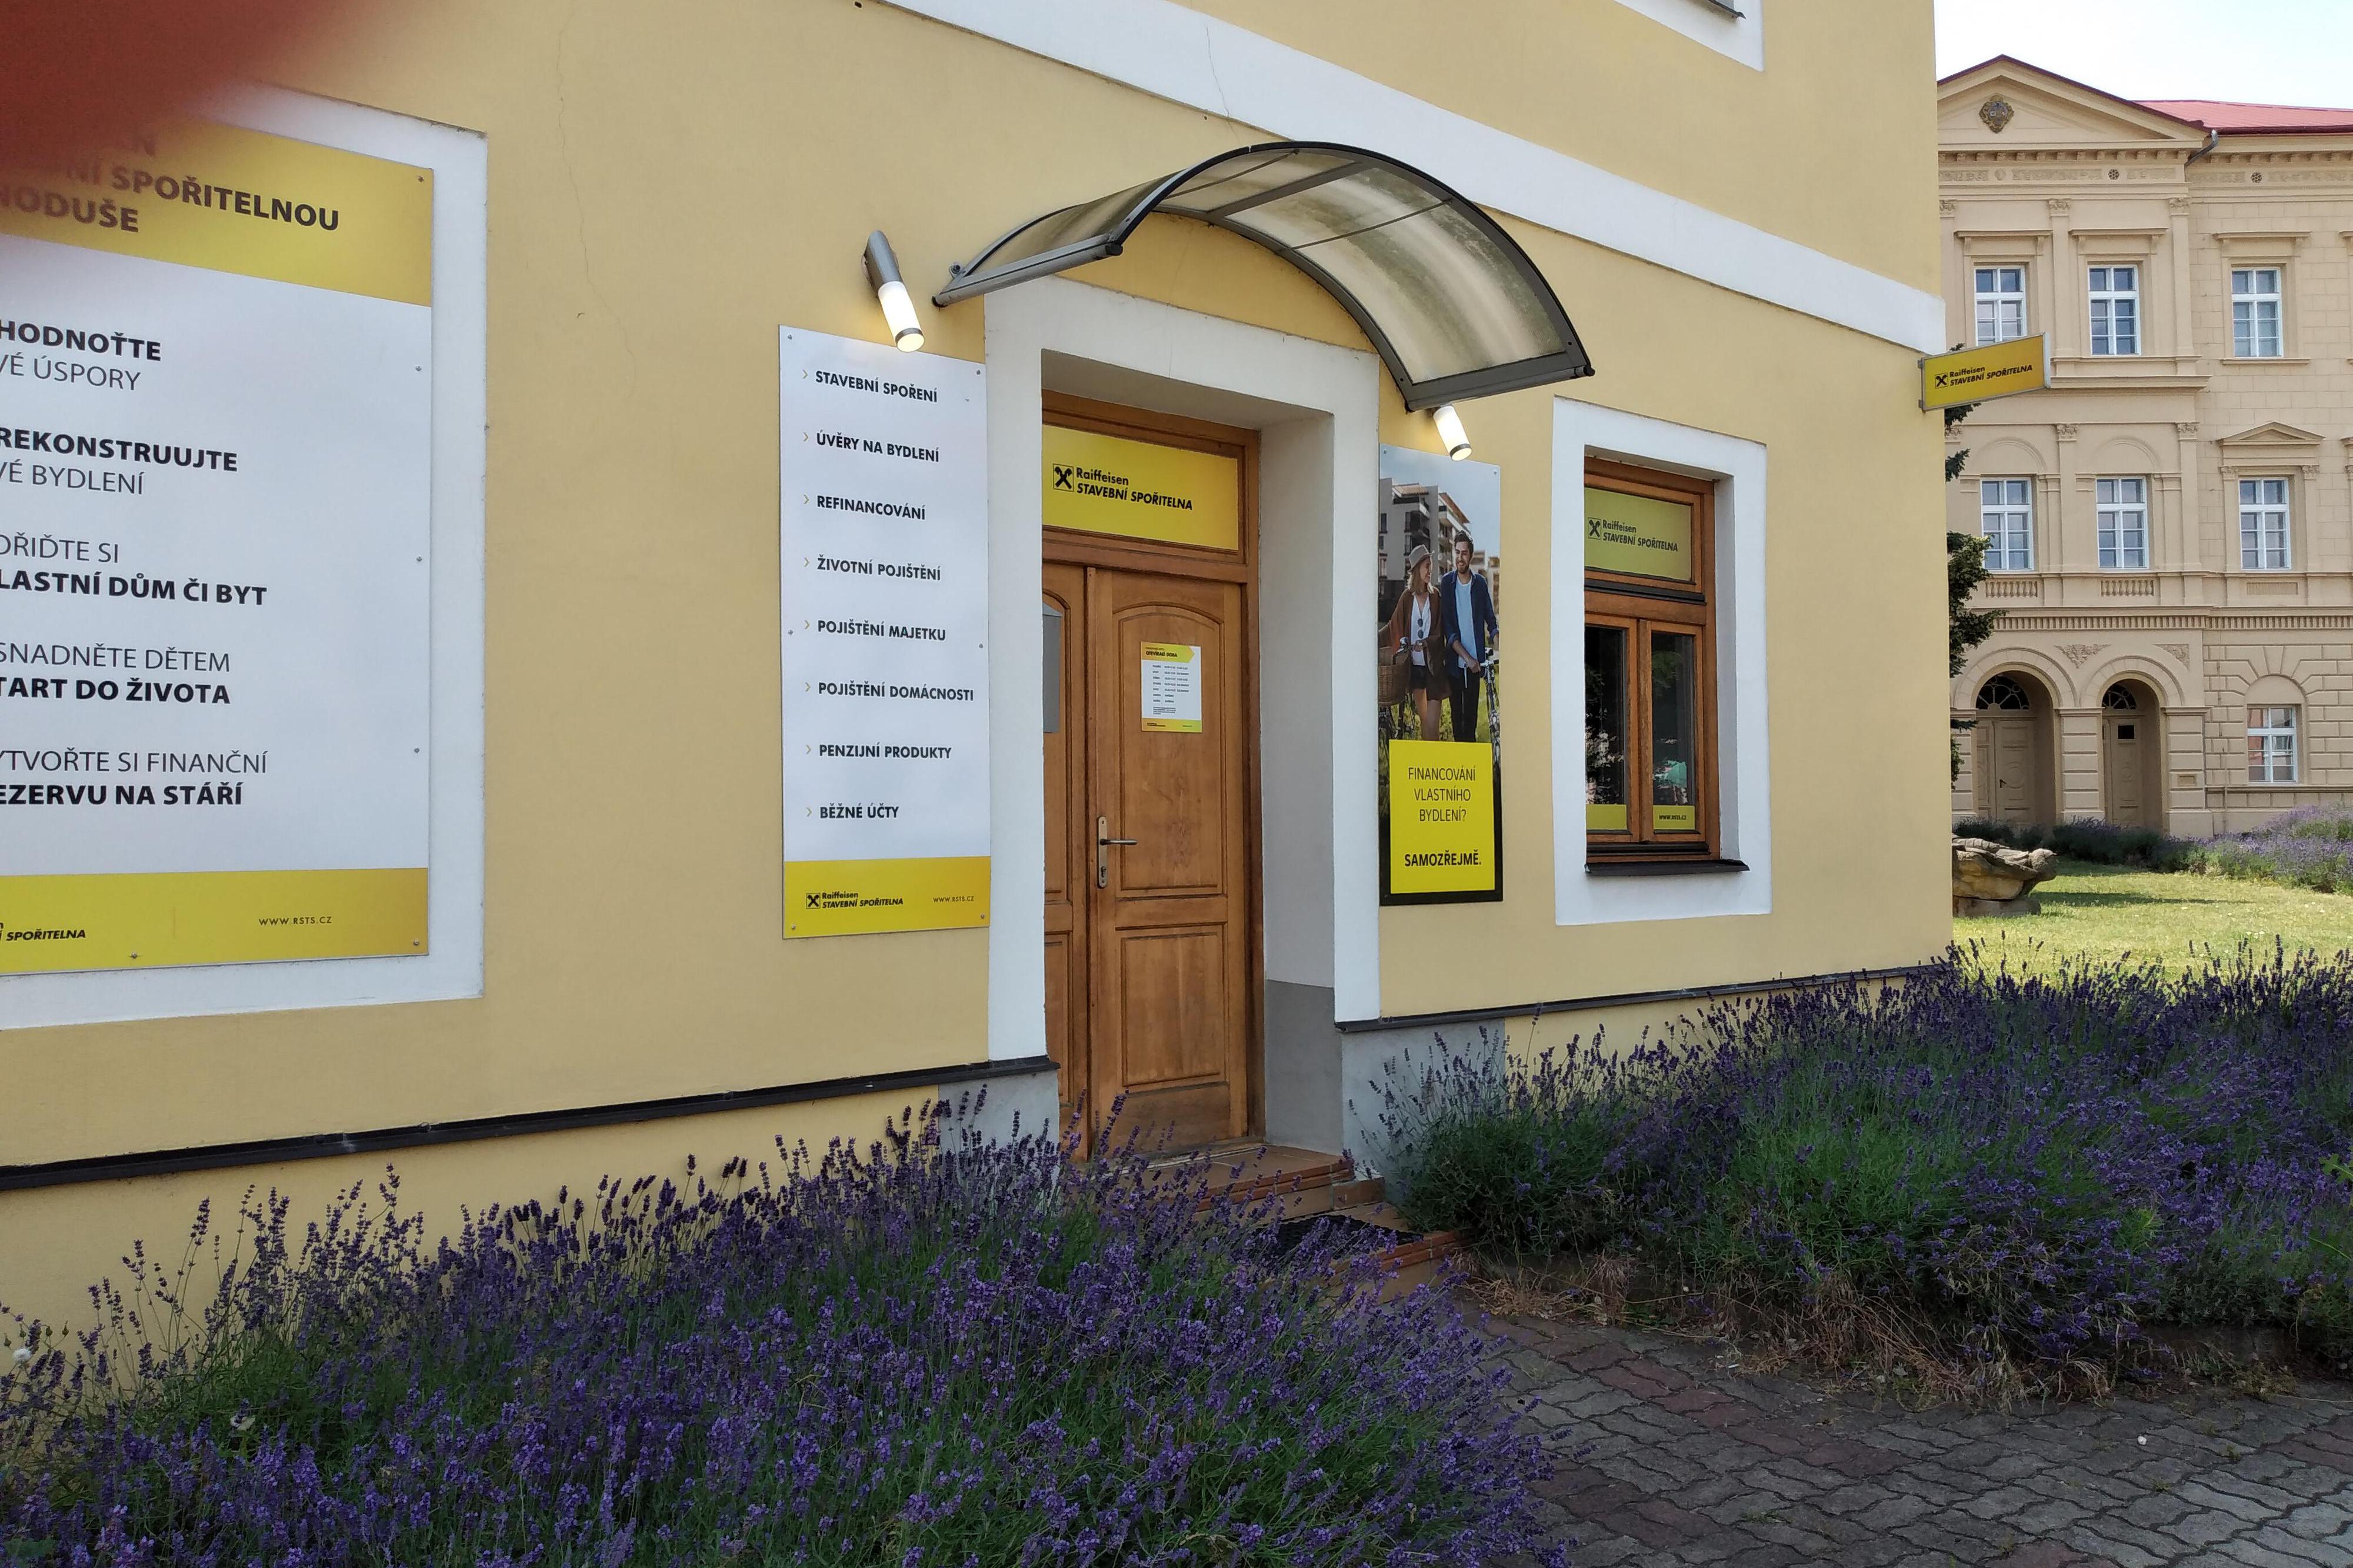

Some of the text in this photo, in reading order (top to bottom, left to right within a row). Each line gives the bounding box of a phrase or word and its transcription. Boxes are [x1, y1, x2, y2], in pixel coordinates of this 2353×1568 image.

[112, 164, 339, 231] SPOŘITELNOU
[0, 319, 161, 361] HODNOŤTE
[34, 355, 141, 391] ÚSPORY
[1949, 366, 1985, 378] Raiffeisen
[1949, 365, 2032, 386] STAVEBNÍ SPOŘITELNA
[815, 371, 937, 402] STAVEBNÍ SPOŘENÍ
[0, 427, 237, 471] REKONSTRUUJTE
[816, 429, 939, 462] ÚVĚRY NA BYDLENÍ
[32, 465, 145, 495] BYDLENÍ
[1076, 467, 1129, 486] Raiffeisen
[817, 495, 926, 520] REFINANCOVÁNÍ
[1076, 483, 1193, 511] STAVEBNÍ SPOŘITELNA
[1602, 519, 1637, 533] Raiffeisen
[1602, 532, 1678, 552] STAVEBNÍ SPOŘITELNA
[98, 543, 118, 563] SI
[817, 554, 941, 581] ŽIVOTNÍ POJIŠTĚNÍ
[0, 569, 267, 606] LASTNÍ DŮM ČI BYT
[818, 619, 946, 641] POJIŠTĚNÍ MAJETKU
[0, 642, 230, 672] SNADNĚTE DĚTEM
[76, 679, 118, 700] DO
[126, 678, 231, 704] ŽIVOTA
[818, 680, 974, 701] POJIŠTĚNÍ DOMÁCNOSTI
[0, 748, 268, 773] TVOŘTE SI FINANČNÍ
[819, 742, 952, 759] PENZIJNÍ PRODUKTY
[1408, 765, 1476, 781] FINANCOVÁNÍ
[116, 785, 156, 805] NA
[163, 782, 243, 805] STÁŘÍ
[1414, 786, 1471, 801] VLASTNÍHO
[819, 802, 899, 819] BĚŽNÉ ÚČTY
[1419, 806, 1466, 822] BYDLENÍ?
[1404, 849, 1482, 867] SAMOZŘEJMĚ.
[822, 891, 859, 900] Raiffeisen
[822, 898, 904, 909] STAVEBNÍ SPOŘITELNA
[6, 929, 86, 941] SPOŘITELNA
